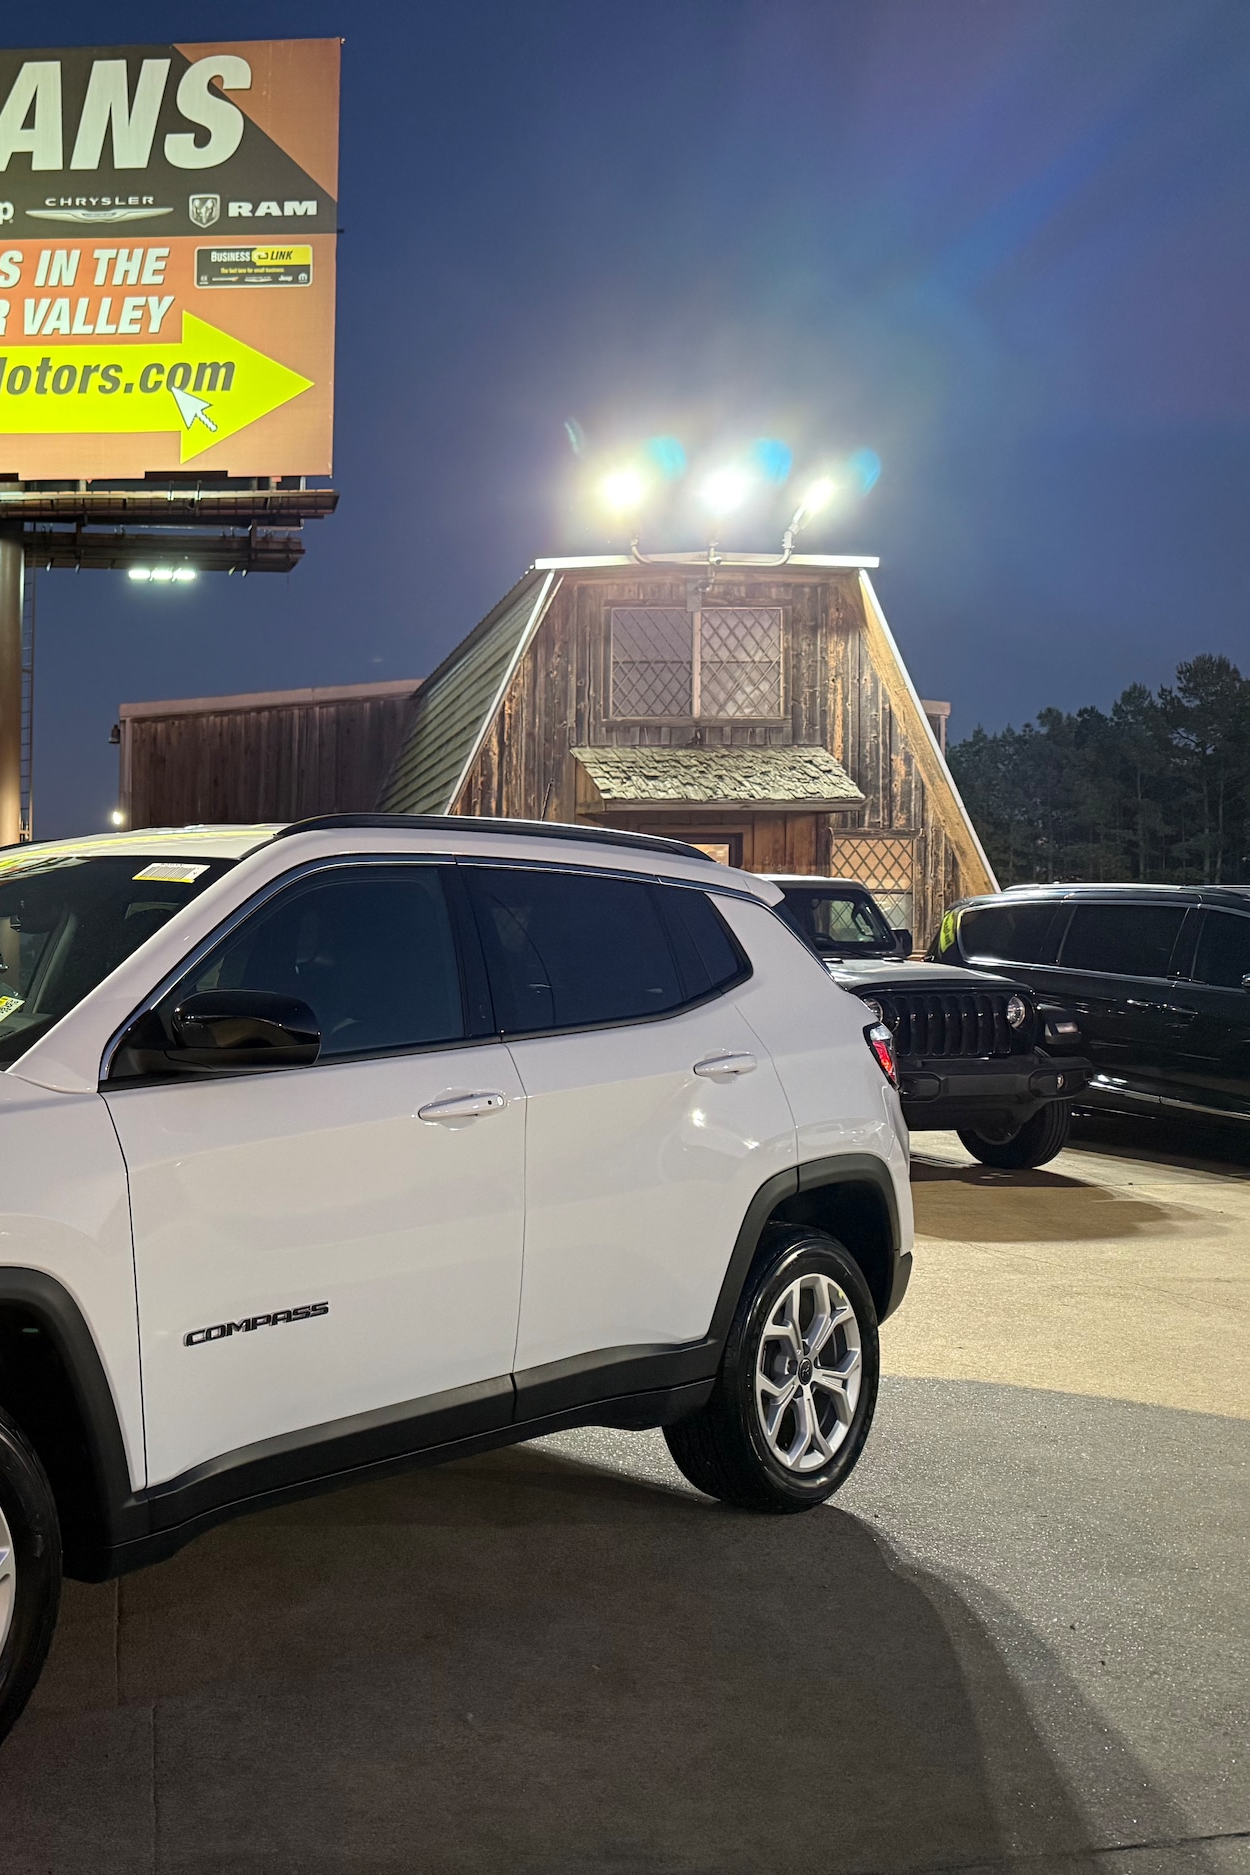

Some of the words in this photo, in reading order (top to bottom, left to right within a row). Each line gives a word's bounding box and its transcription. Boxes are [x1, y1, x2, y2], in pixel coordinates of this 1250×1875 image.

[44, 195, 154, 207] CHRYSLER
[227, 200, 318, 218] RAM
[34, 250, 81, 287] IN
[92, 247, 171, 286] THE
[270, 250, 293, 260] LINK
[23, 295, 175, 337] VALLEY
[183, 1300, 330, 1347] COMPASS
